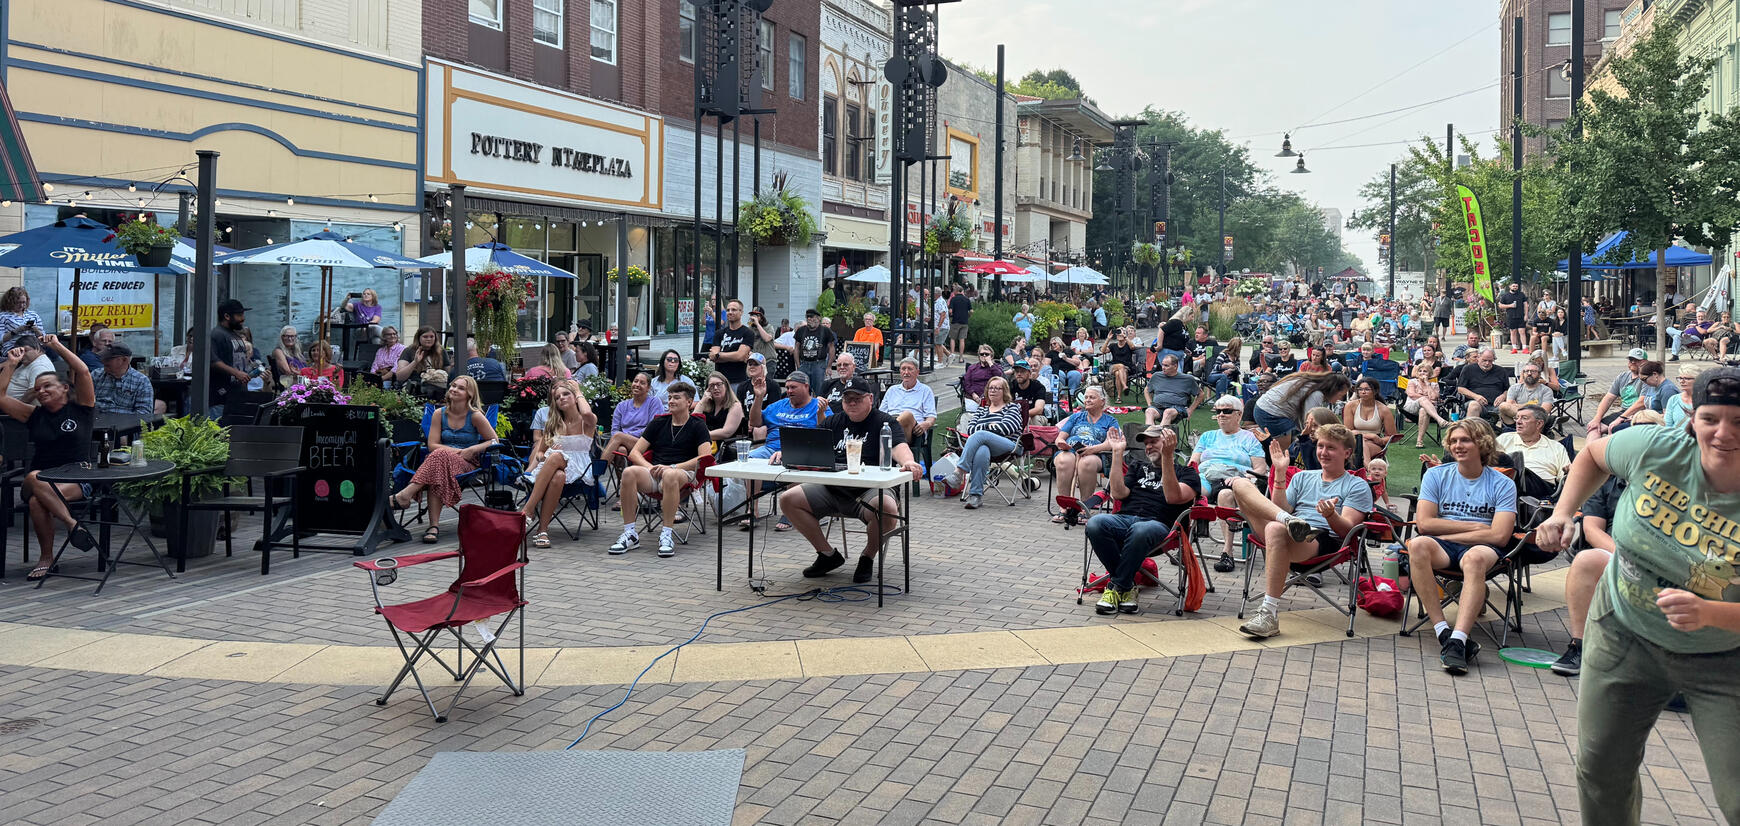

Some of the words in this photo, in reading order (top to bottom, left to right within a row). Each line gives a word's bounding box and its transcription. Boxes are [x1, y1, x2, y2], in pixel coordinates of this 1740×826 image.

[877, 84, 890, 170] Quarry
[470, 132, 543, 164] POTTERY
[50, 251, 129, 264] Miller
[276, 255, 344, 264] Corona
[102, 281, 145, 290] REDUCED
[66, 305, 103, 317] OLTZ
[106, 304, 147, 316] REALTY
[309, 446, 355, 469] BEER
[1643, 472, 1690, 512] THE
